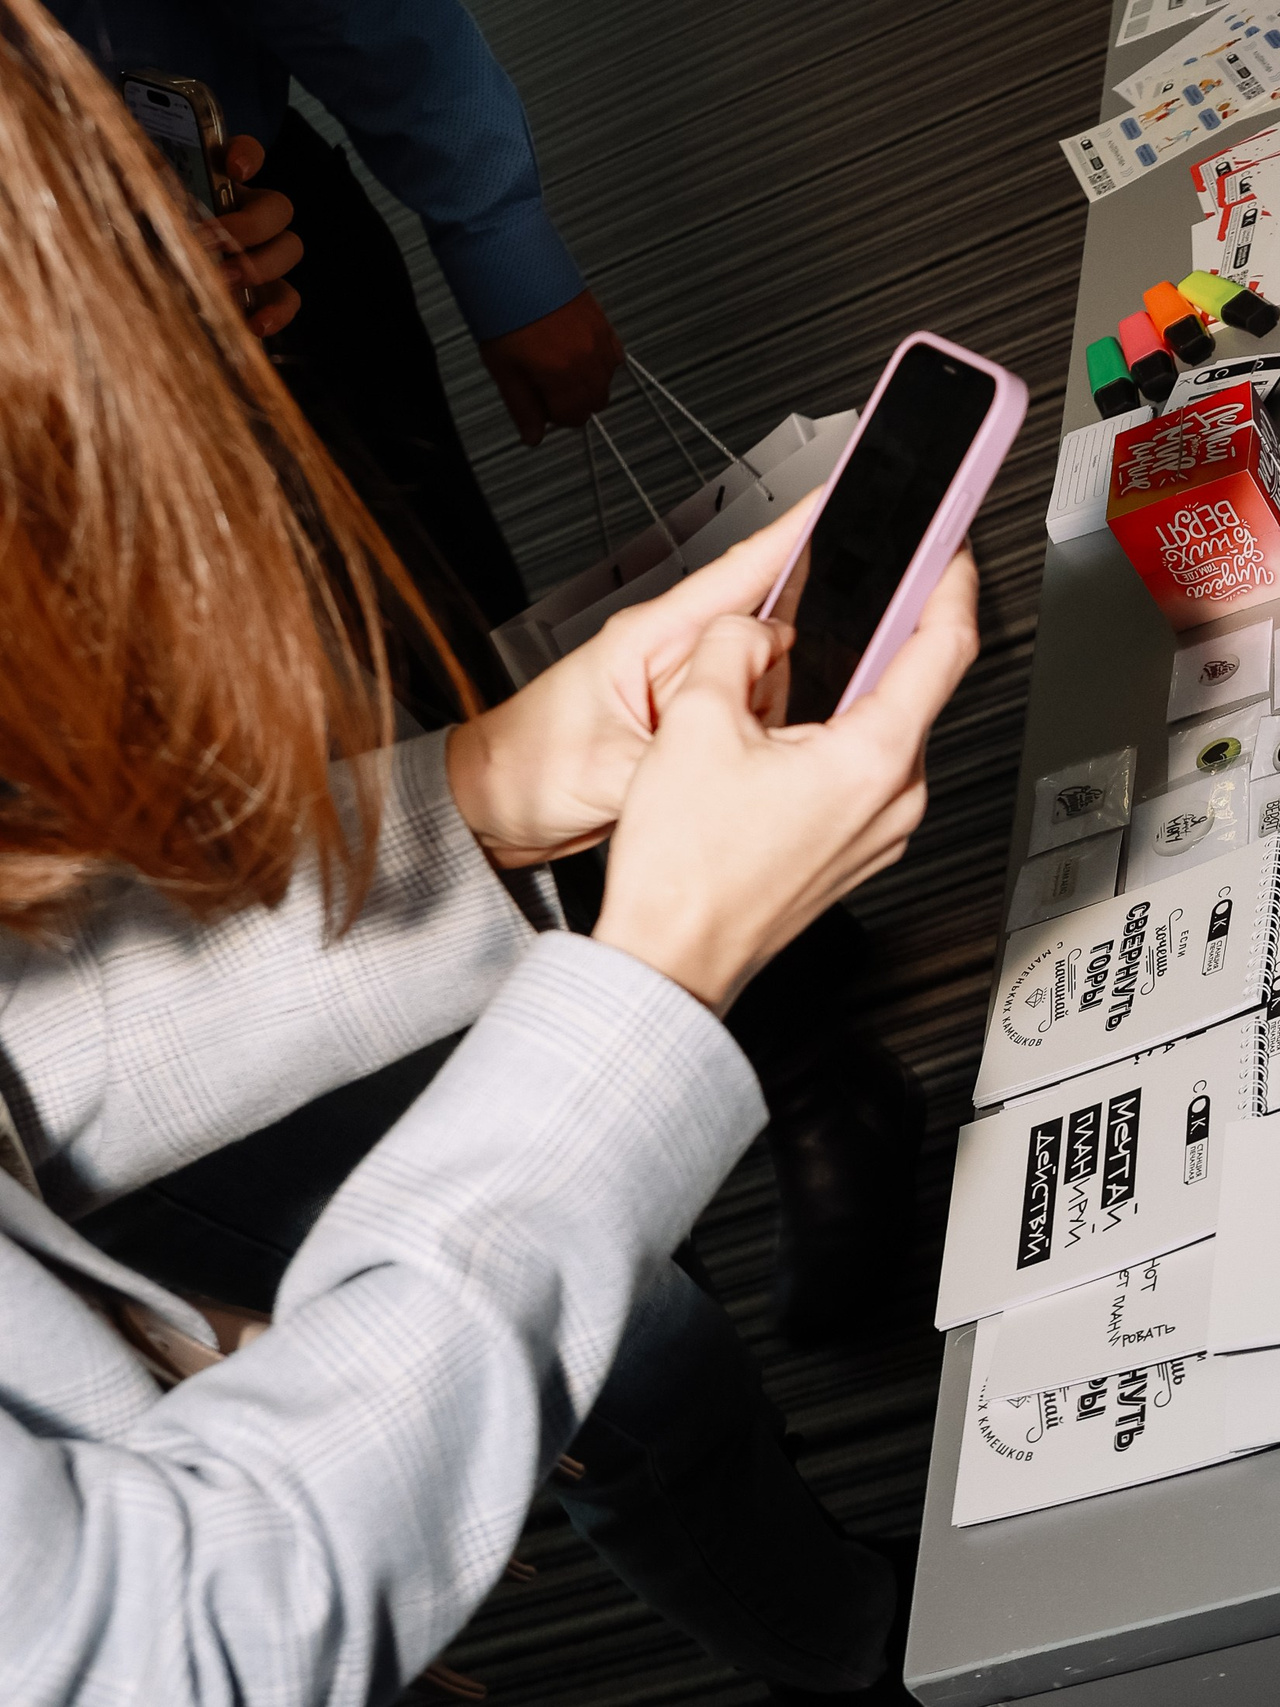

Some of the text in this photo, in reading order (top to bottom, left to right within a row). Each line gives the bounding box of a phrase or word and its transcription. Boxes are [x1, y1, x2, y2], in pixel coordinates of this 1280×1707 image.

[1105, 901, 1151, 1032] СВЕРНУТЬ
[1155, 925, 1168, 977] хочешь
[1177, 929, 1190, 958] ЕСЛИ
[1002, 948, 1052, 1014] МАЛЕНЬКИХ
[1054, 959, 1069, 1021] начинай
[1078, 940, 1115, 1013] ГОРЫ
[1002, 1017, 1043, 1047] КАМЕШКОВ
[1193, 1142, 1204, 1179] СТАНЦИЯ
[977, 1414, 1034, 1462] КАМЕШКОВ
